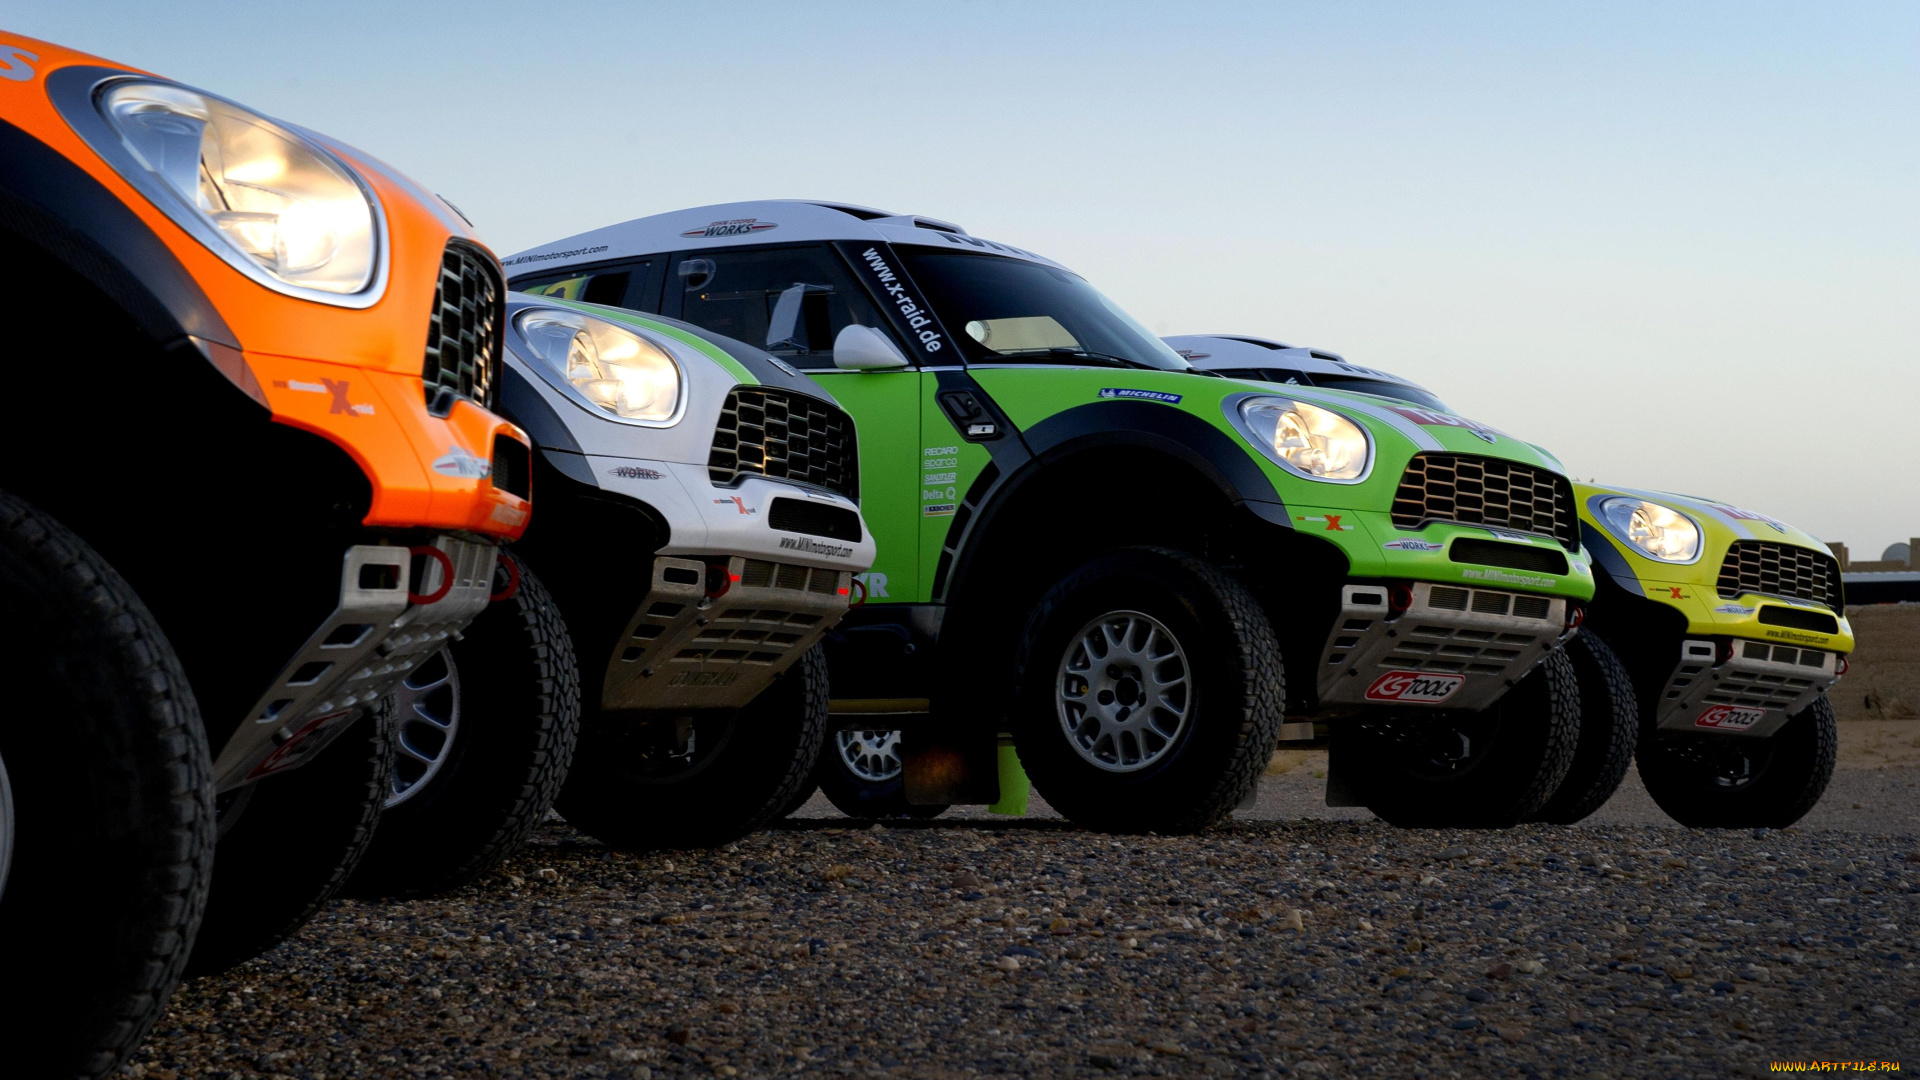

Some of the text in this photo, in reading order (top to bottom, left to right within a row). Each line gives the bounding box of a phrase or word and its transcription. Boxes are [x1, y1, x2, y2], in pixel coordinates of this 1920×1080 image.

[704, 223, 753, 236] WORKS
[501, 245, 608, 266] w.MINImotorsport.com
[862, 247, 941, 352] www.x-raid.de
[1118, 390, 1179, 401] MICHELIN
[924, 446, 959, 456] RECARO
[617, 468, 659, 480] WORKS
[923, 486, 956, 500] Delta Q
[779, 537, 853, 558] www.MINImotorsport.com
[1400, 541, 1429, 550] WORKS
[1462, 569, 1556, 587] www.MINImotorsport.com
[1405, 679, 1457, 697] TOOLS
[1722, 711, 1760, 725] TOOLS
